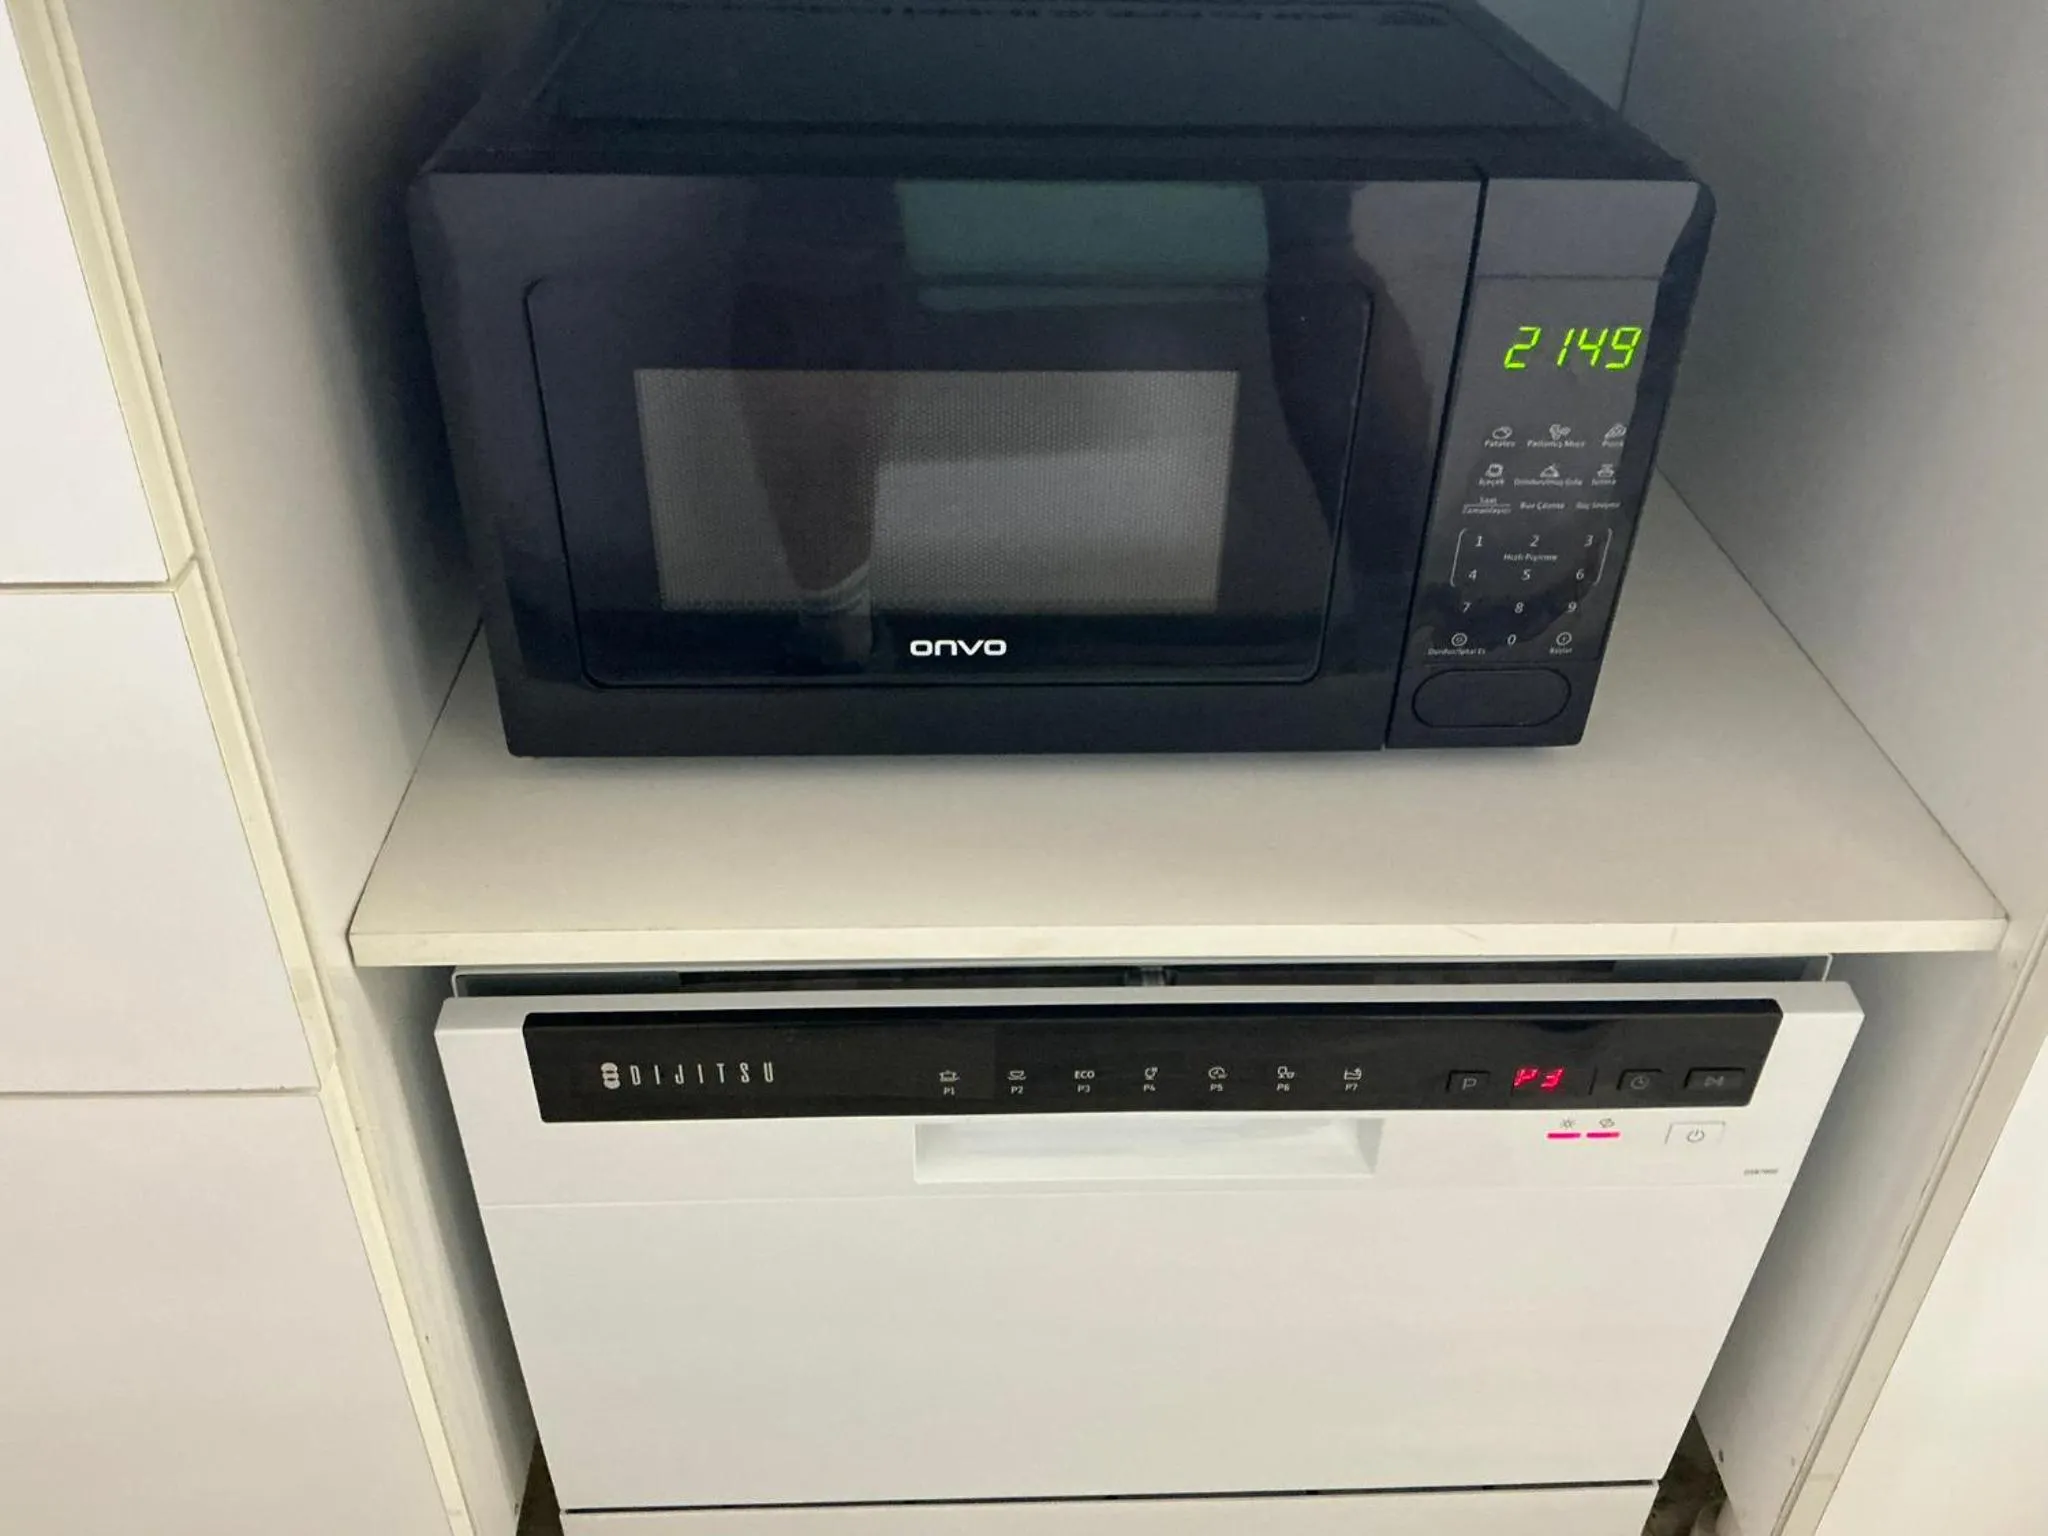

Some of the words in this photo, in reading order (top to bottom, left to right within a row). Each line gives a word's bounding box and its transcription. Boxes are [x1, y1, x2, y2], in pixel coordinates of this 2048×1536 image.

[1475, 535, 1483, 547] 1
[1529, 534, 1540, 547] 2
[1583, 534, 1594, 547] 3
[1468, 568, 1478, 580] 4
[1521, 568, 1531, 581] 5
[1575, 568, 1585, 580] 6
[1462, 601, 1472, 613] 7
[1514, 601, 1525, 614] 8
[1567, 601, 1578, 613] 9
[1506, 633, 1517, 646] 0
[629, 1061, 774, 1086] DIJITSU
[1074, 1069, 1096, 1080] ECO
[943, 1086, 956, 1096] P1
[1010, 1085, 1024, 1095] P2
[1077, 1084, 1091, 1094] P3
[1143, 1083, 1156, 1092] P4
[1210, 1083, 1224, 1092] P5
[1276, 1083, 1290, 1092] P6
[1344, 1082, 1359, 1091] P7
